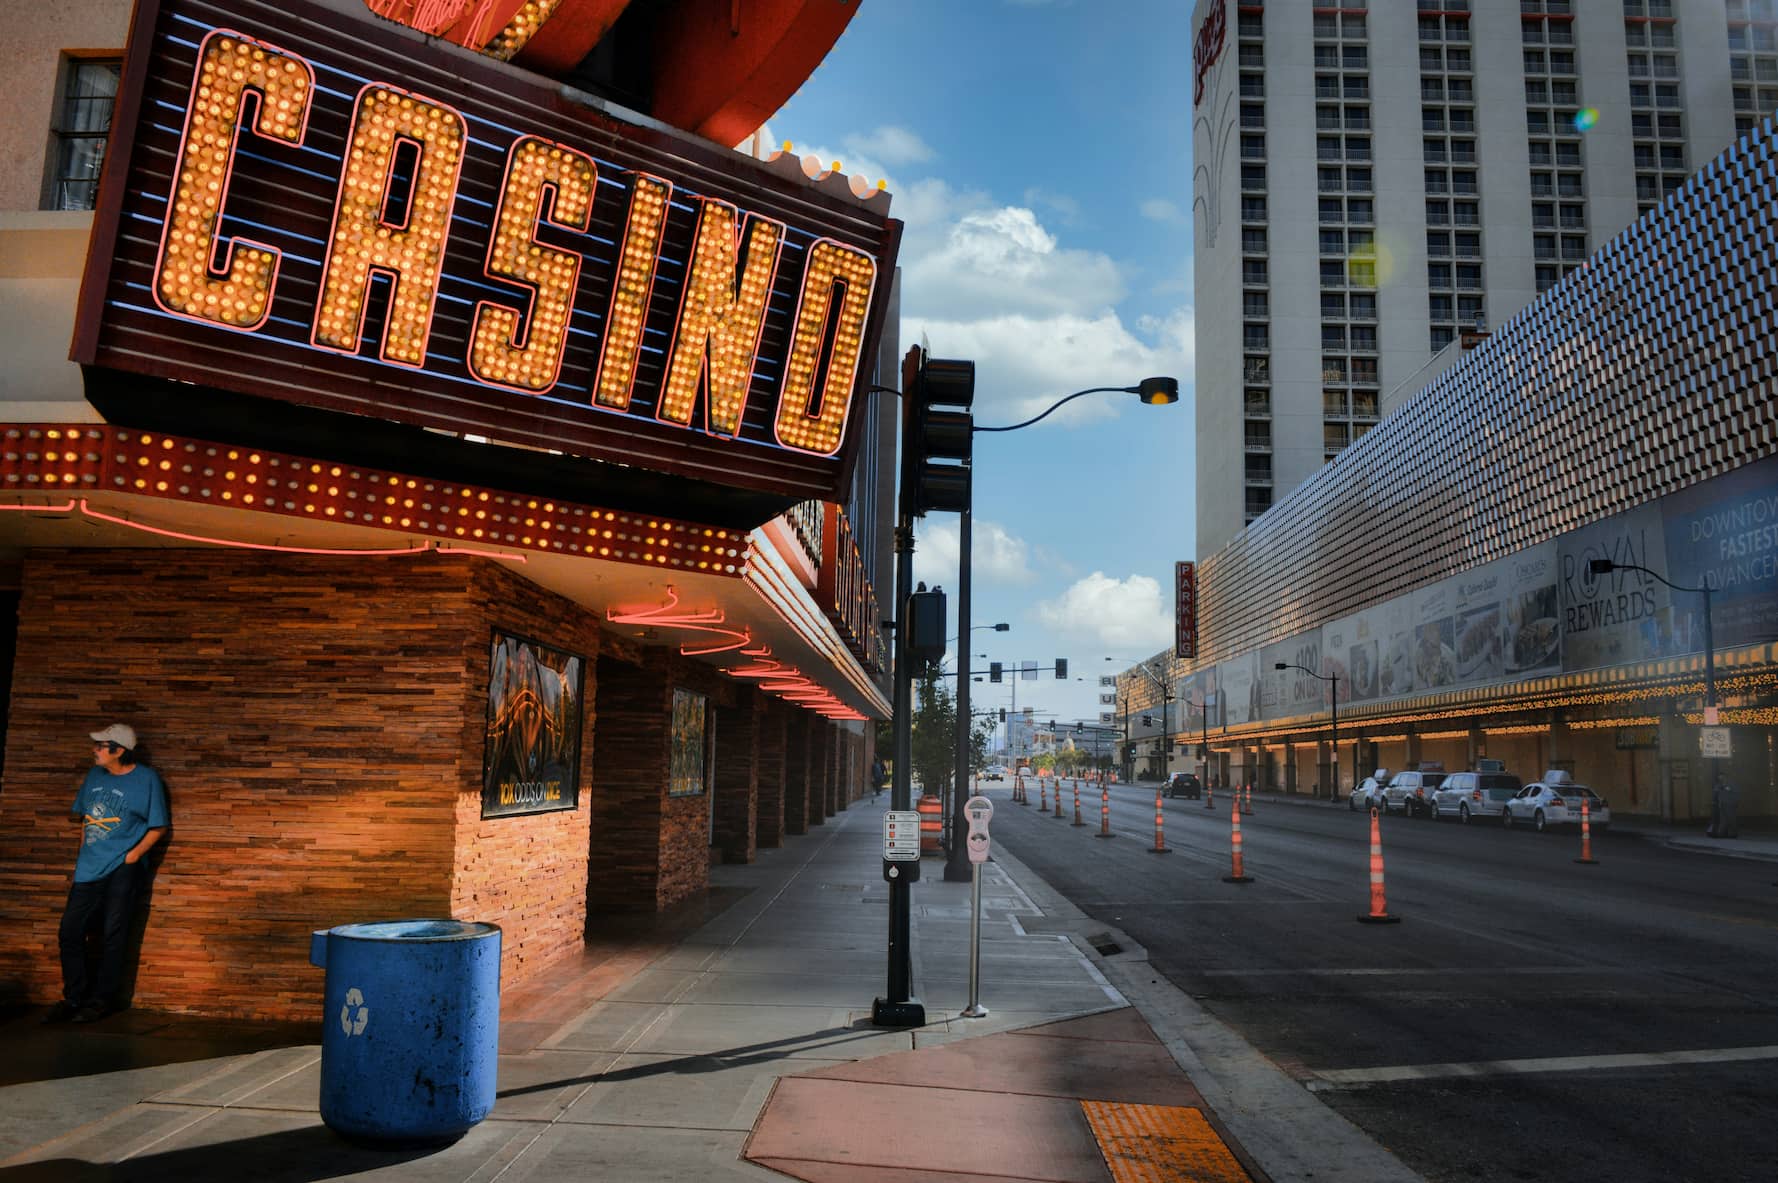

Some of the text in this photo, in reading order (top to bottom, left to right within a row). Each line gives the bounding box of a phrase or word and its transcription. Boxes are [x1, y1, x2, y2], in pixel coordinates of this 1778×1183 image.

[152, 27, 877, 458] CASINO
[1562, 528, 1654, 603] ROYAL
[1181, 564, 1192, 652] PARKING
[1566, 587, 1656, 633] REWARDS
[1295, 643, 1318, 677] $100
[1102, 677, 1112, 722] BUS
